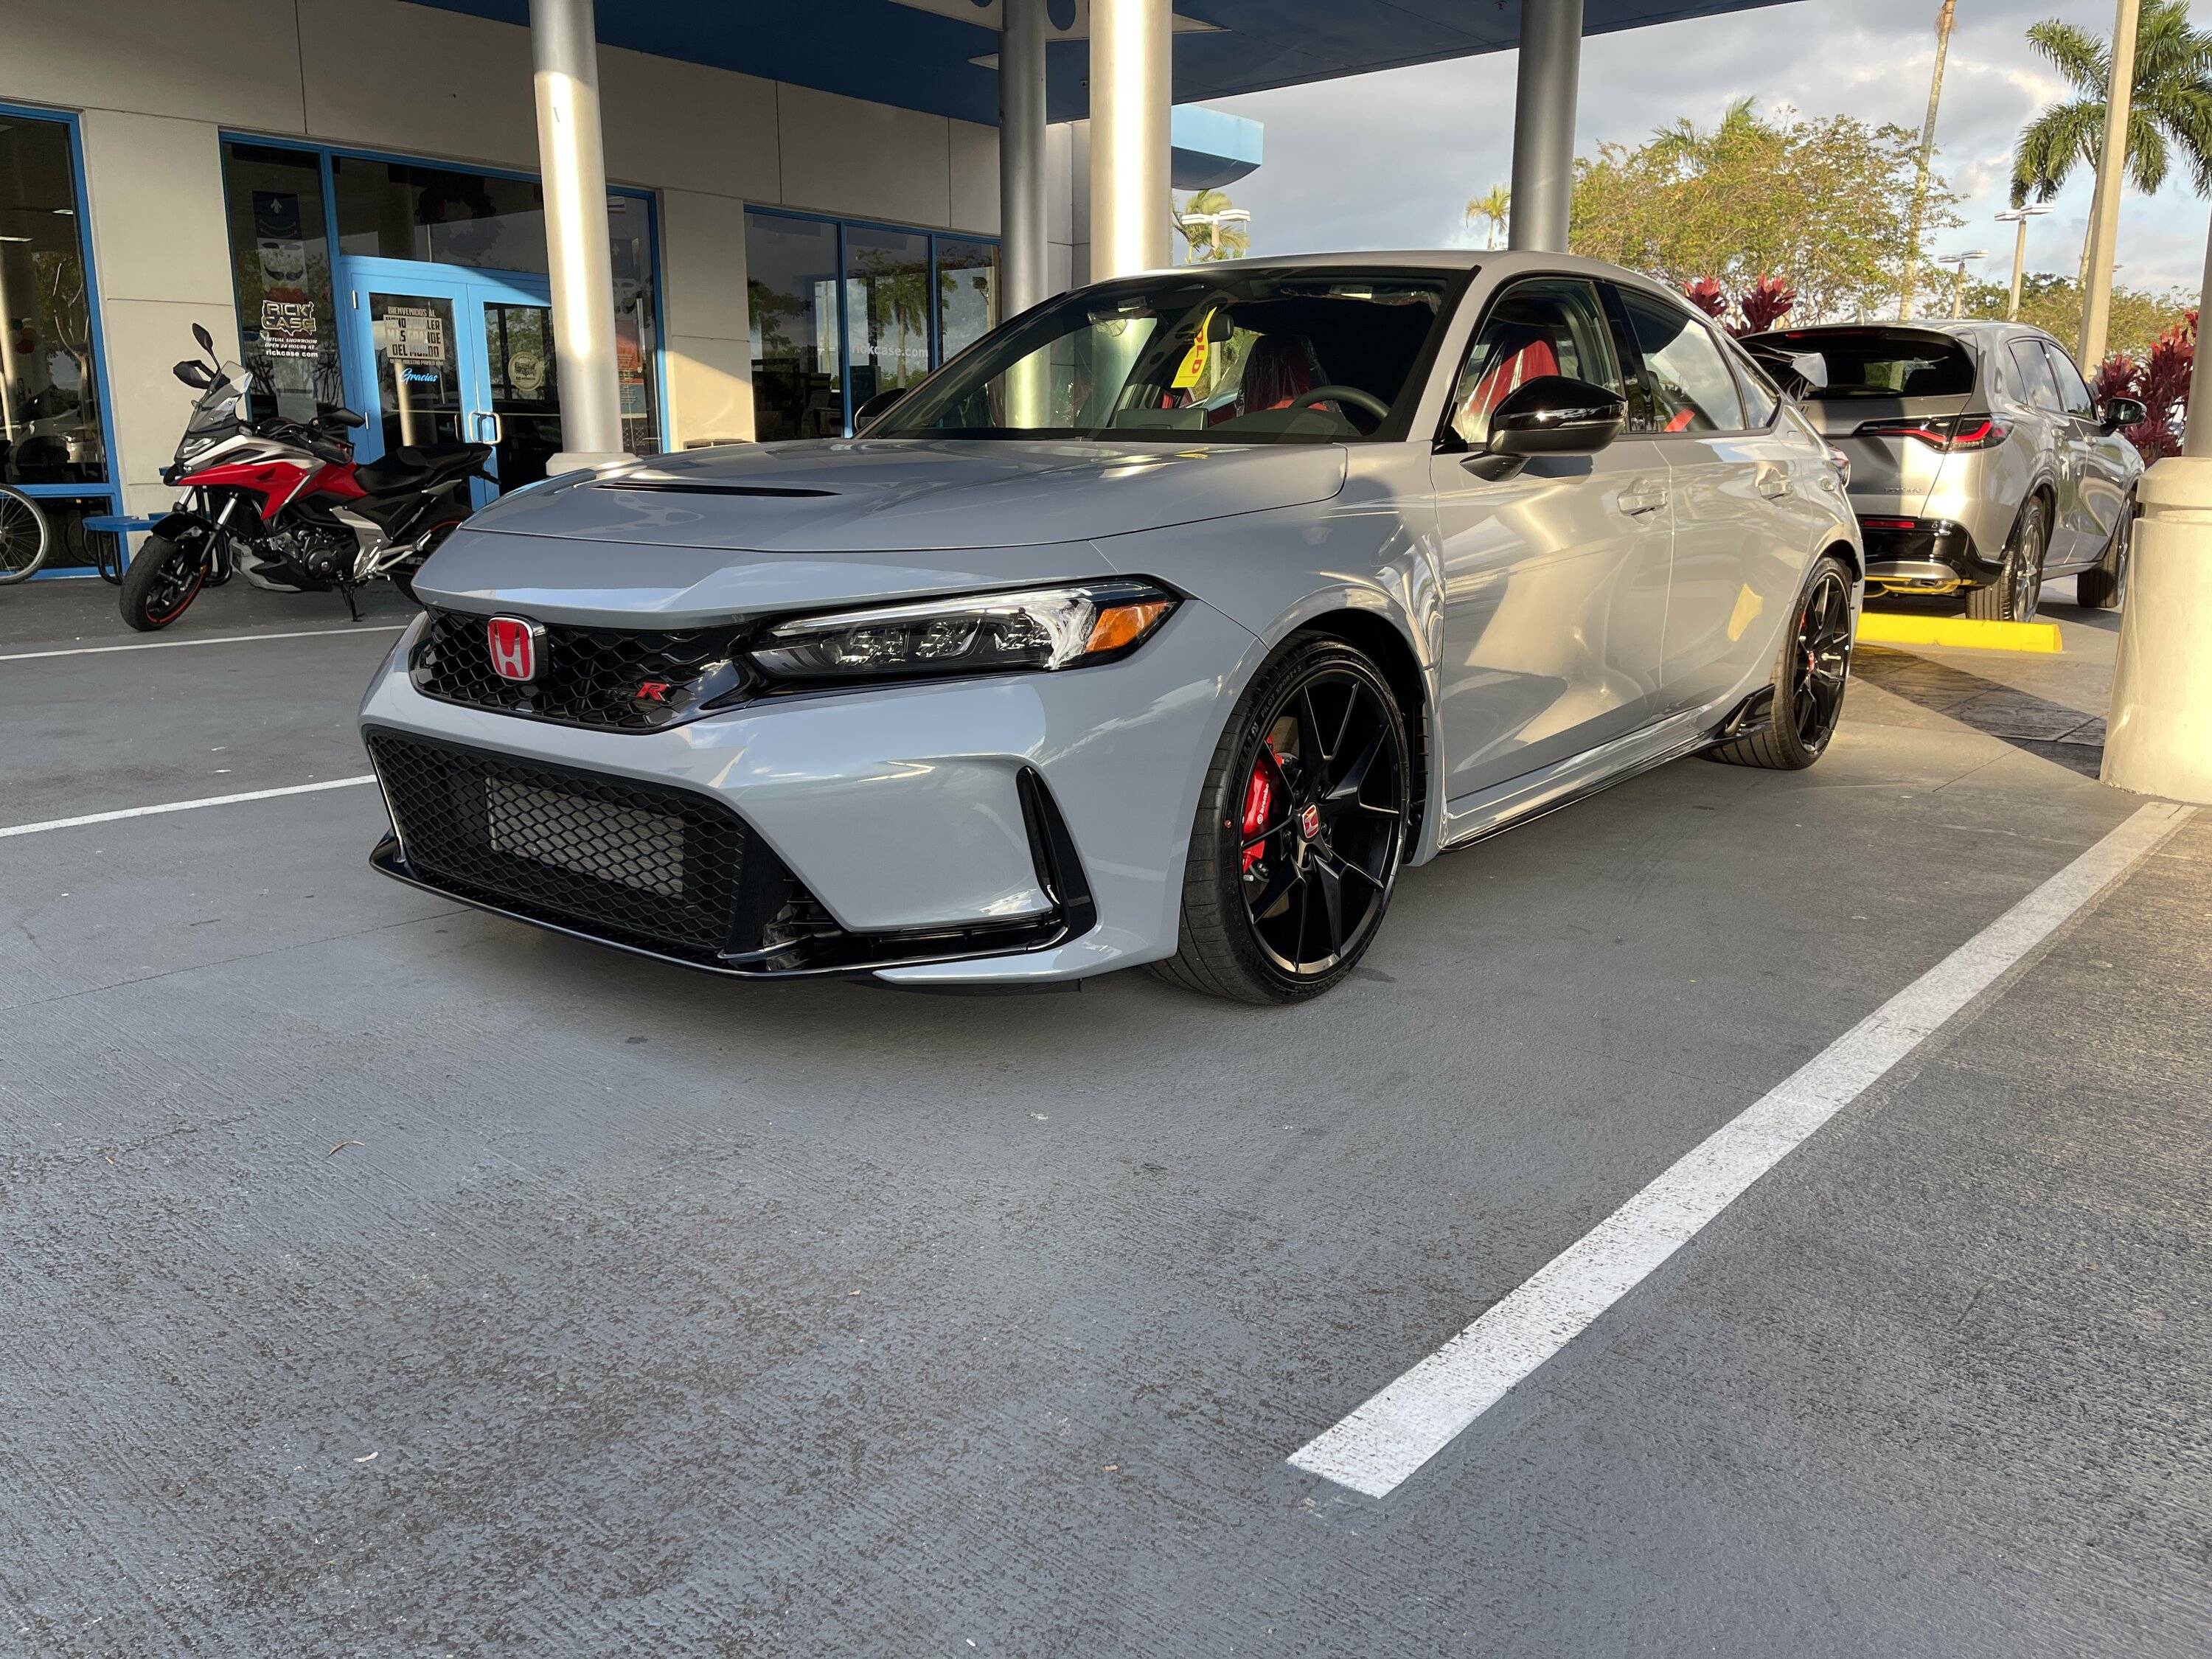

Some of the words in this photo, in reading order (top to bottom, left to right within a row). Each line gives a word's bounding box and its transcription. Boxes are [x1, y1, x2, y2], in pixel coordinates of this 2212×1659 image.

[267, 303, 307, 316] RICK
[388, 306, 427, 316] BIENVENIDOS
[428, 309, 437, 317] AL
[263, 316, 316, 330] CASE
[265, 349, 319, 358] rickcasecom
[392, 344, 408, 356] DEL
[851, 345, 928, 358] rickcase.com
[1192, 328, 1205, 374] OLD
[400, 367, 438, 385] Gracias
[1261, 693, 1276, 719] PILOT
[1276, 671, 1293, 695] SPORT
[1259, 783, 1269, 814] brembo
